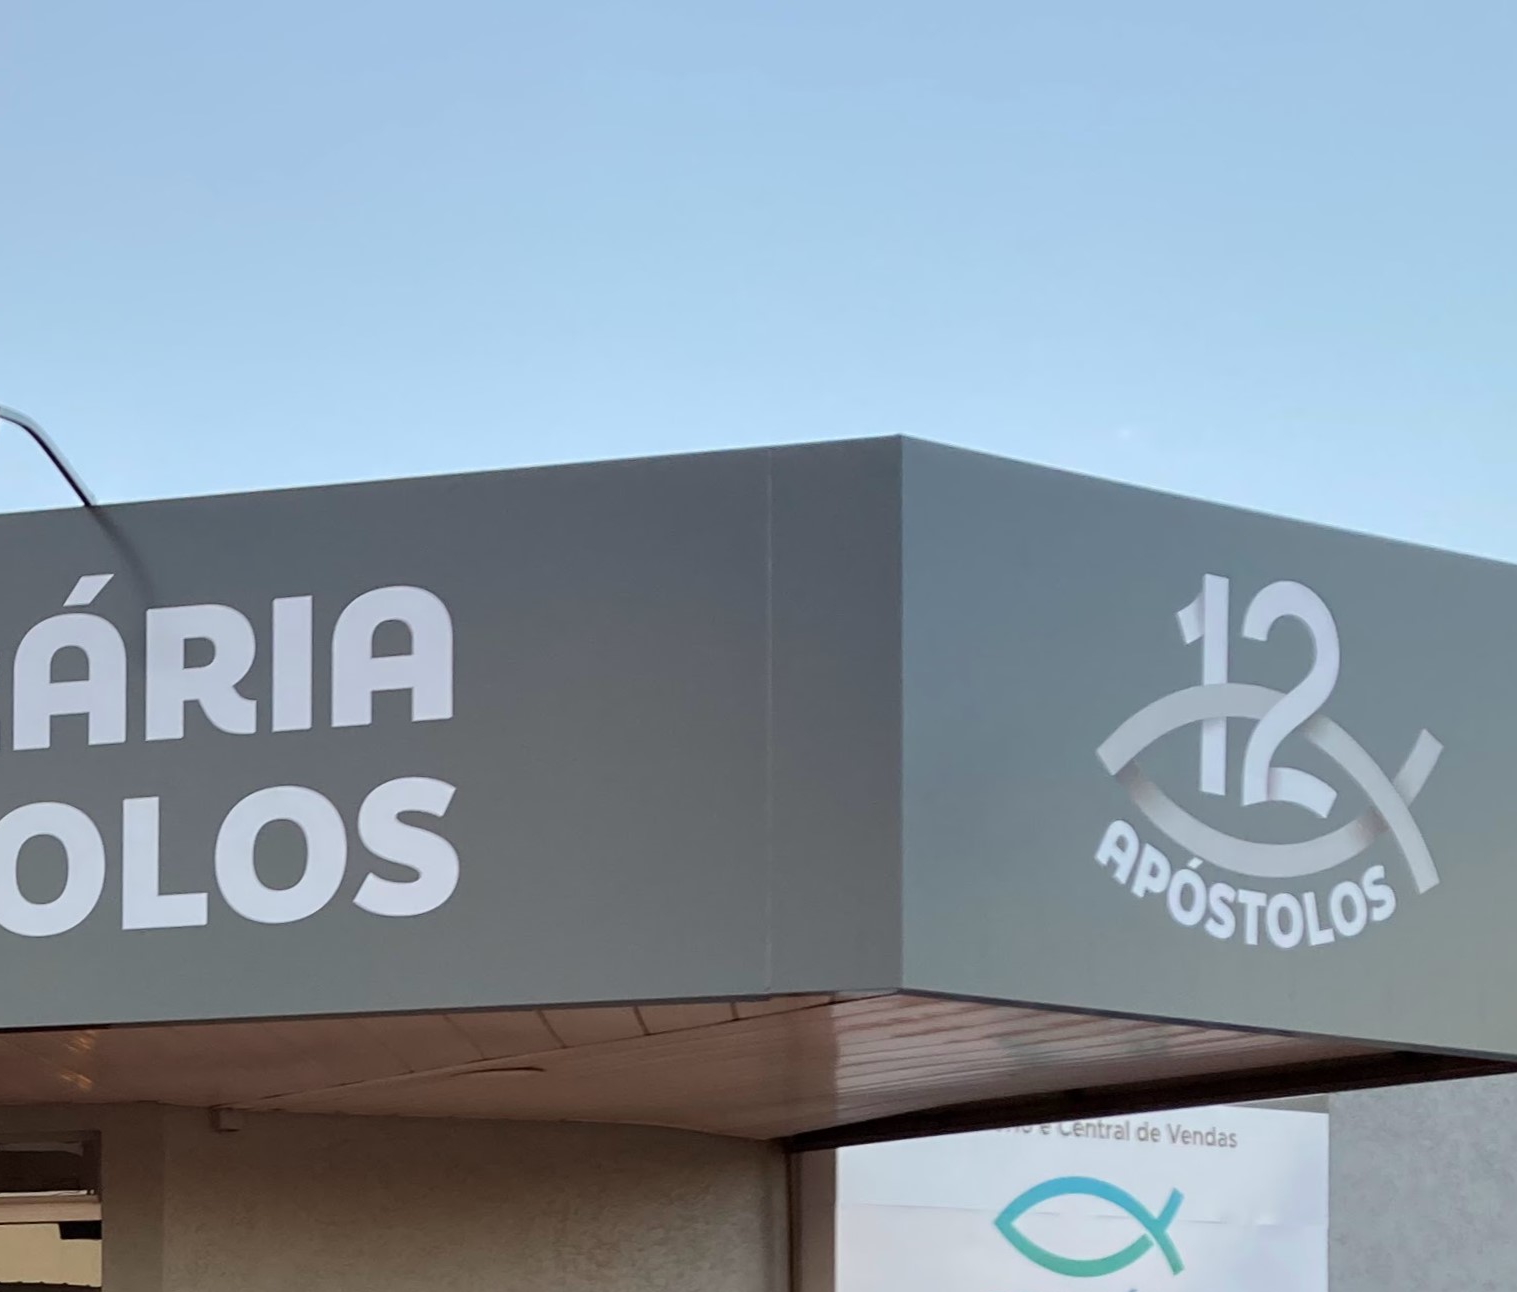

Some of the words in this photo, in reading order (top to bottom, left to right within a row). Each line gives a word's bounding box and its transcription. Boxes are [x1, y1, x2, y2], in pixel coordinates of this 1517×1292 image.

[1176, 573, 1340, 818] 12
[1094, 819, 1397, 949] APÓSTOLOS
[1057, 1119, 1131, 1141] Central
[1136, 1121, 1161, 1142] de
[1166, 1123, 1238, 1148] Vendas
